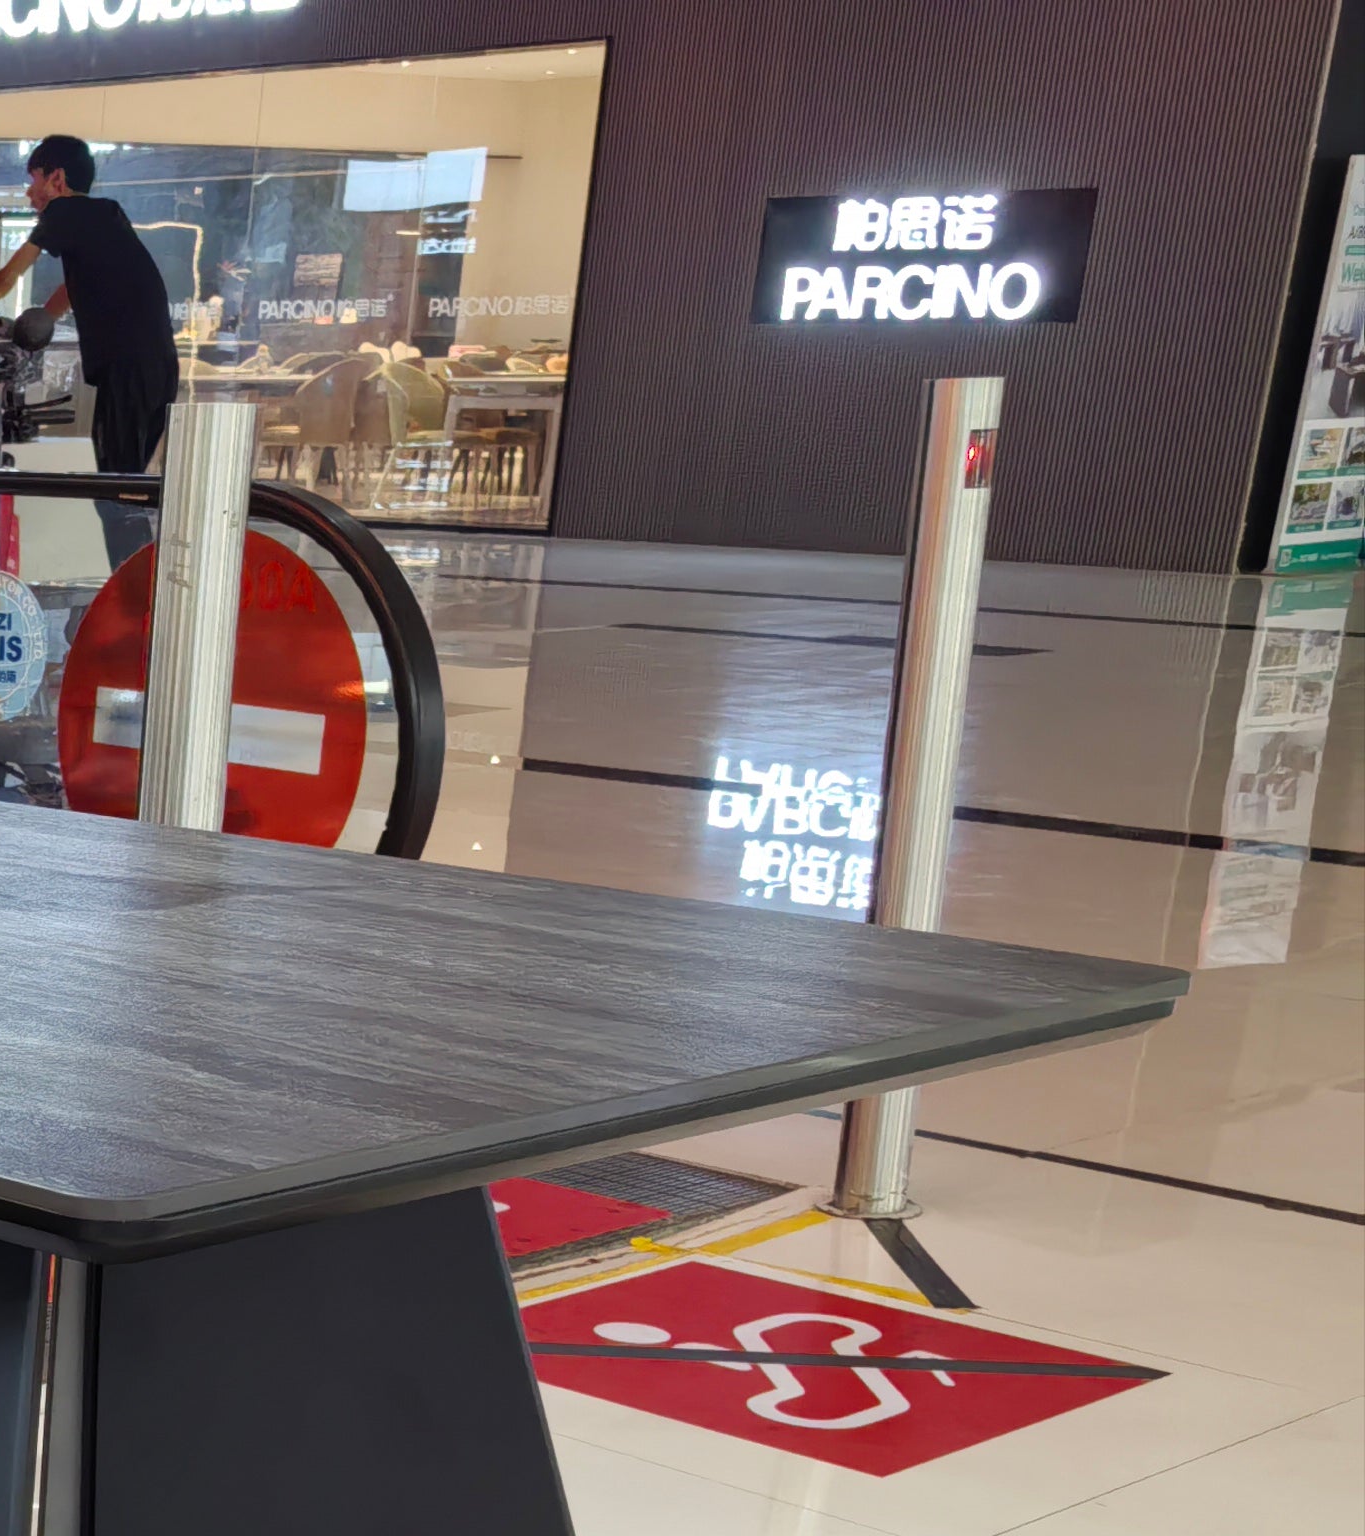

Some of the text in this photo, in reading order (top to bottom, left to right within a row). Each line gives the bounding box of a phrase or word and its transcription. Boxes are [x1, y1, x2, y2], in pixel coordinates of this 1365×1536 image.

[780, 262, 1041, 321] PARCINO
[258, 299, 334, 320] PARCINO
[428, 296, 513, 318] PARCINO
